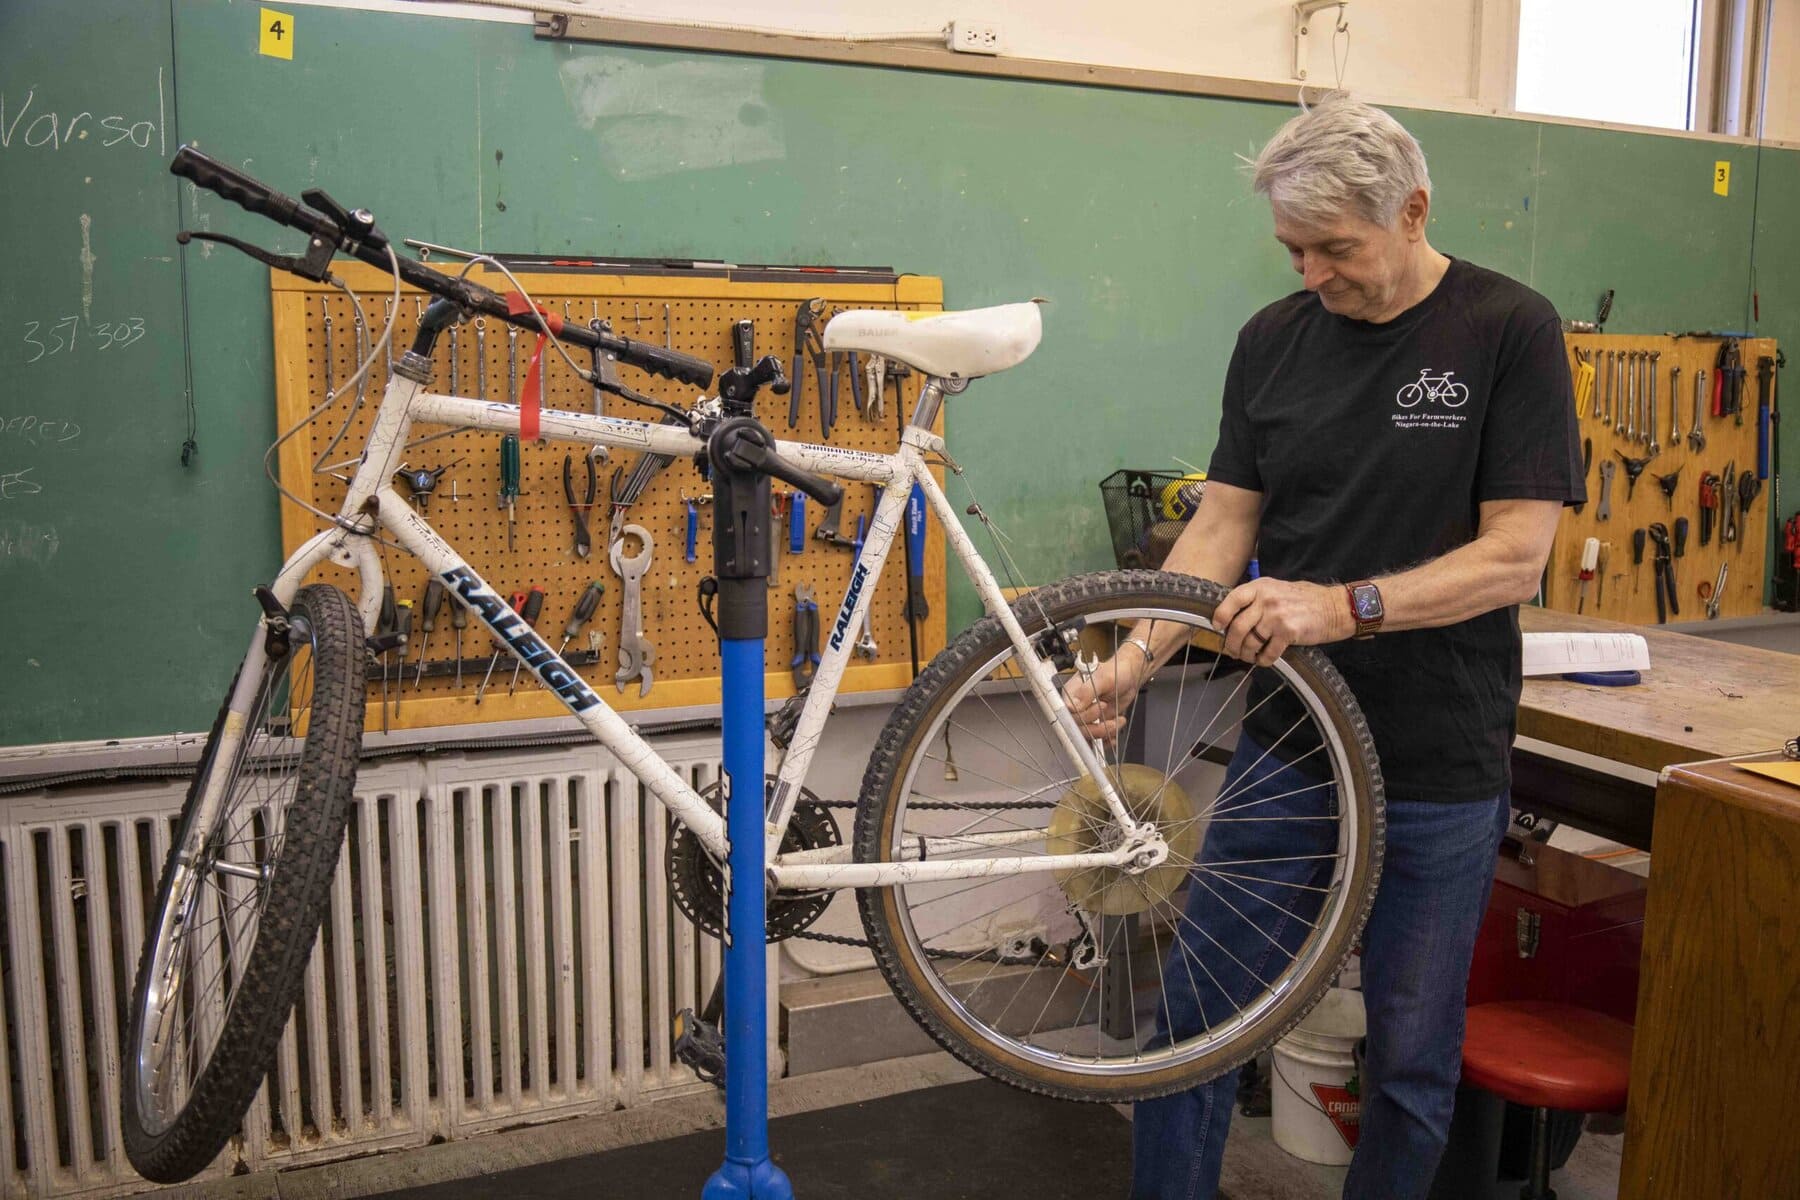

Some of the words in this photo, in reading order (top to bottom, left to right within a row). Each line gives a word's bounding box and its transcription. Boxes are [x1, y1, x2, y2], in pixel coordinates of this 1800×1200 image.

[270, 20, 285, 40] 4
[1717, 168, 1726, 182] 3
[830, 563, 869, 652] RALEIGH
[440, 565, 601, 713] RALEIGH
